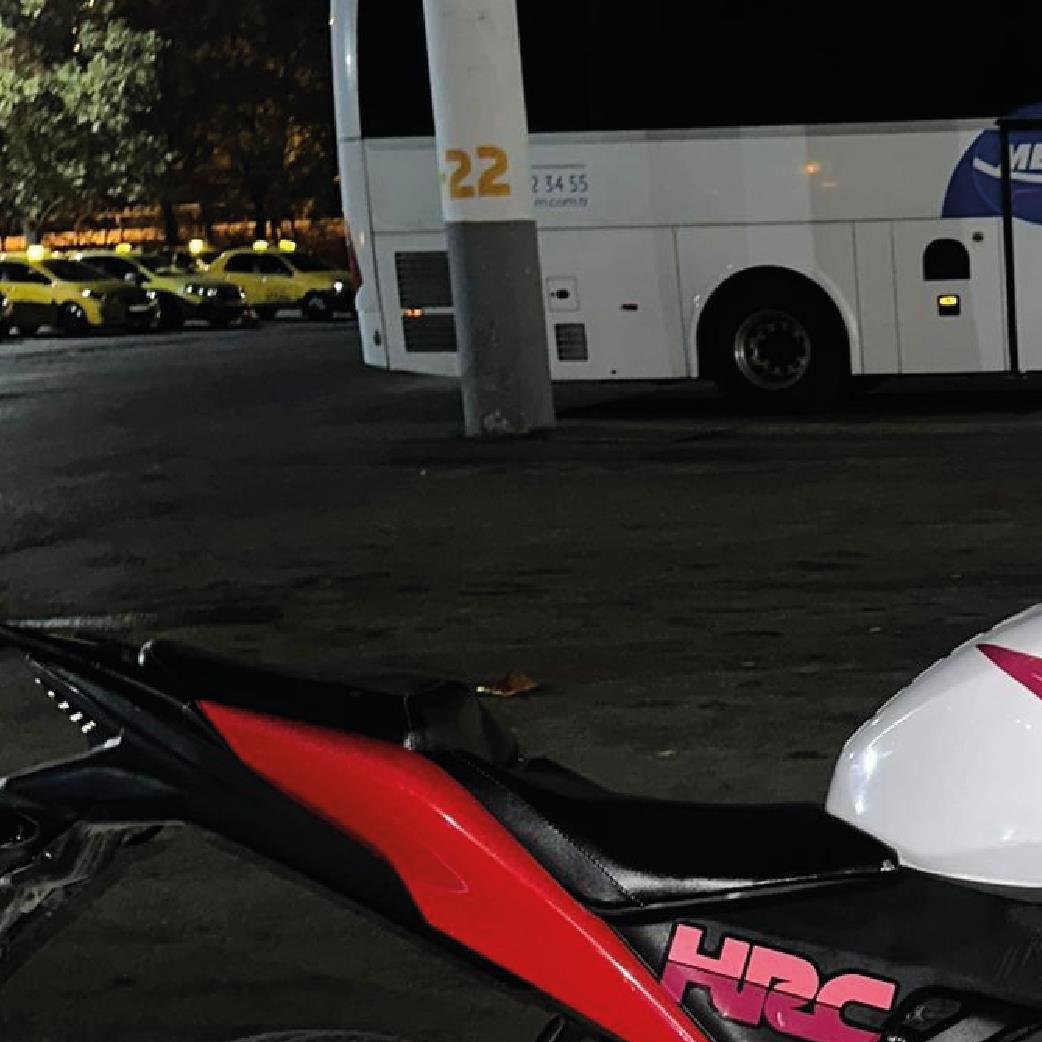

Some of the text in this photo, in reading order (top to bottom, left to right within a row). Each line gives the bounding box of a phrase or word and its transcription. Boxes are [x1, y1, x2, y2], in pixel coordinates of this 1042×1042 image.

[445, 145, 511, 198] 22
[545, 175, 563, 193] 34
[569, 174, 588, 193] 55
